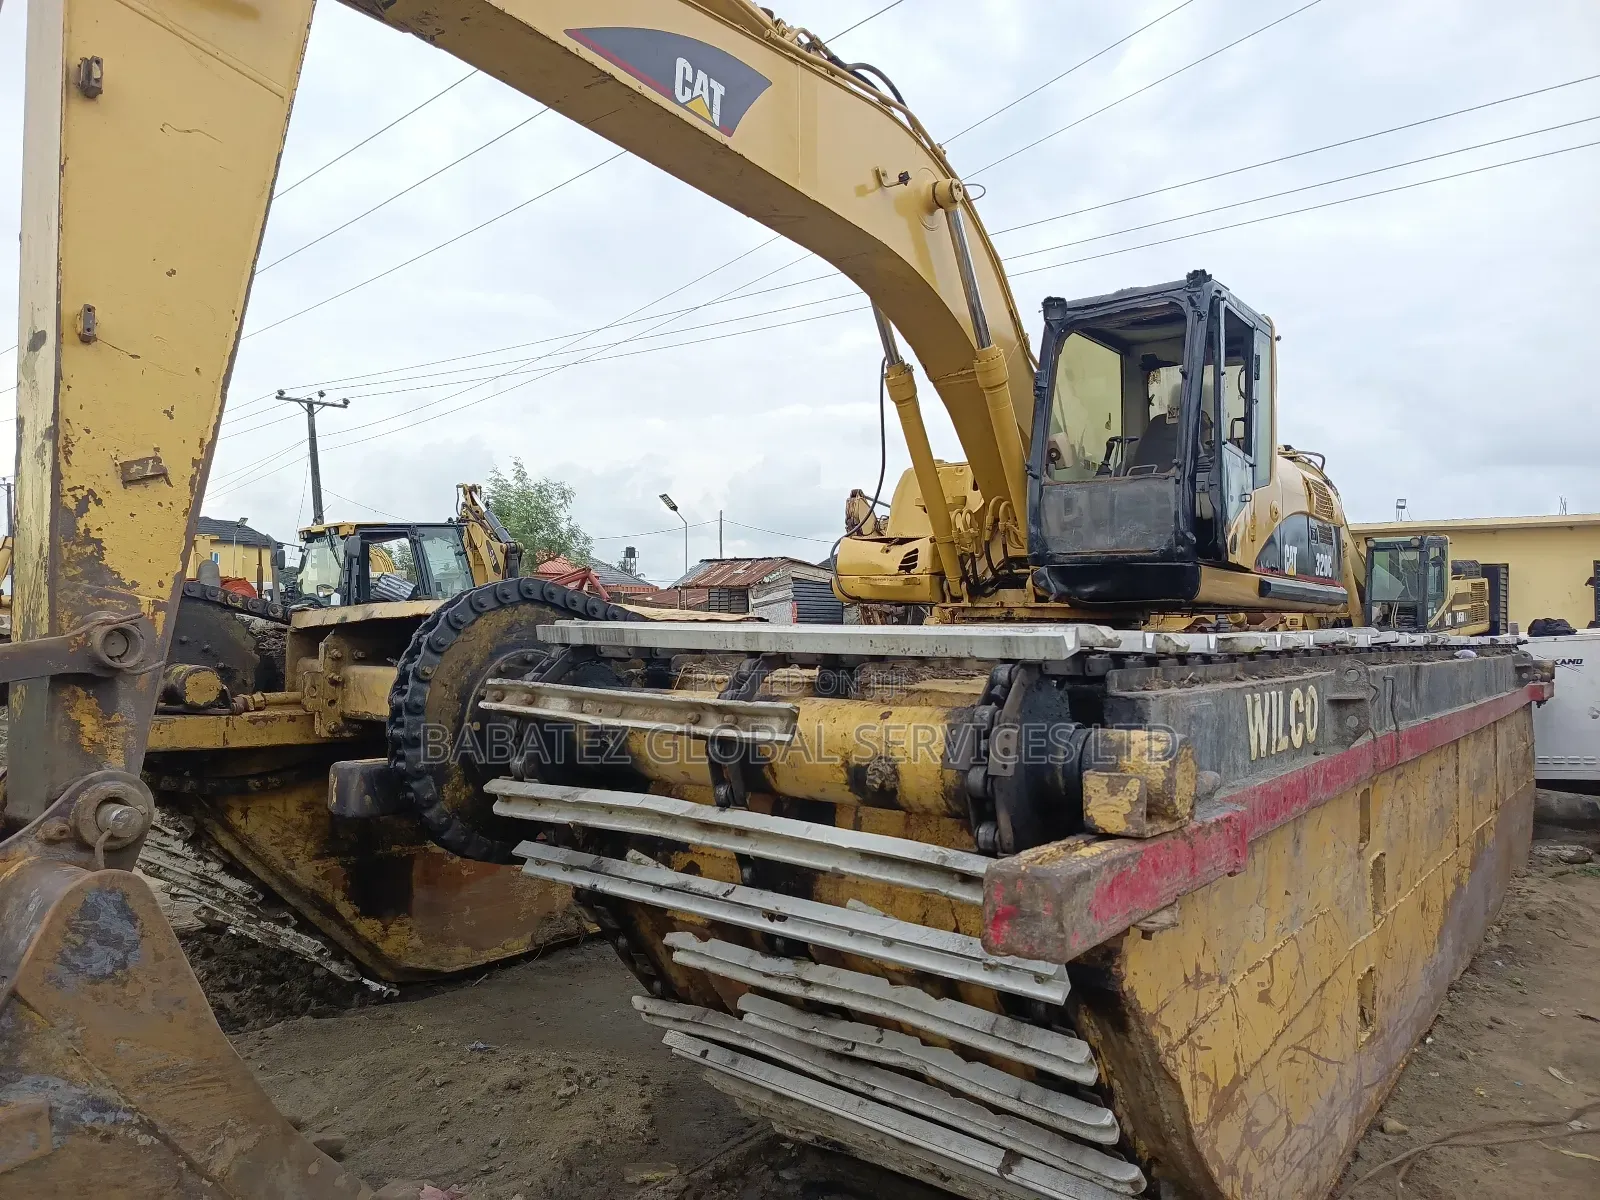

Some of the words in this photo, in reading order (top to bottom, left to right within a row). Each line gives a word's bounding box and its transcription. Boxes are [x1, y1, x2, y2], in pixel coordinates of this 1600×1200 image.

[674, 56, 726, 127] CAT
[1284, 543, 1298, 576] CAT
[1245, 685, 1318, 761] WILCO
